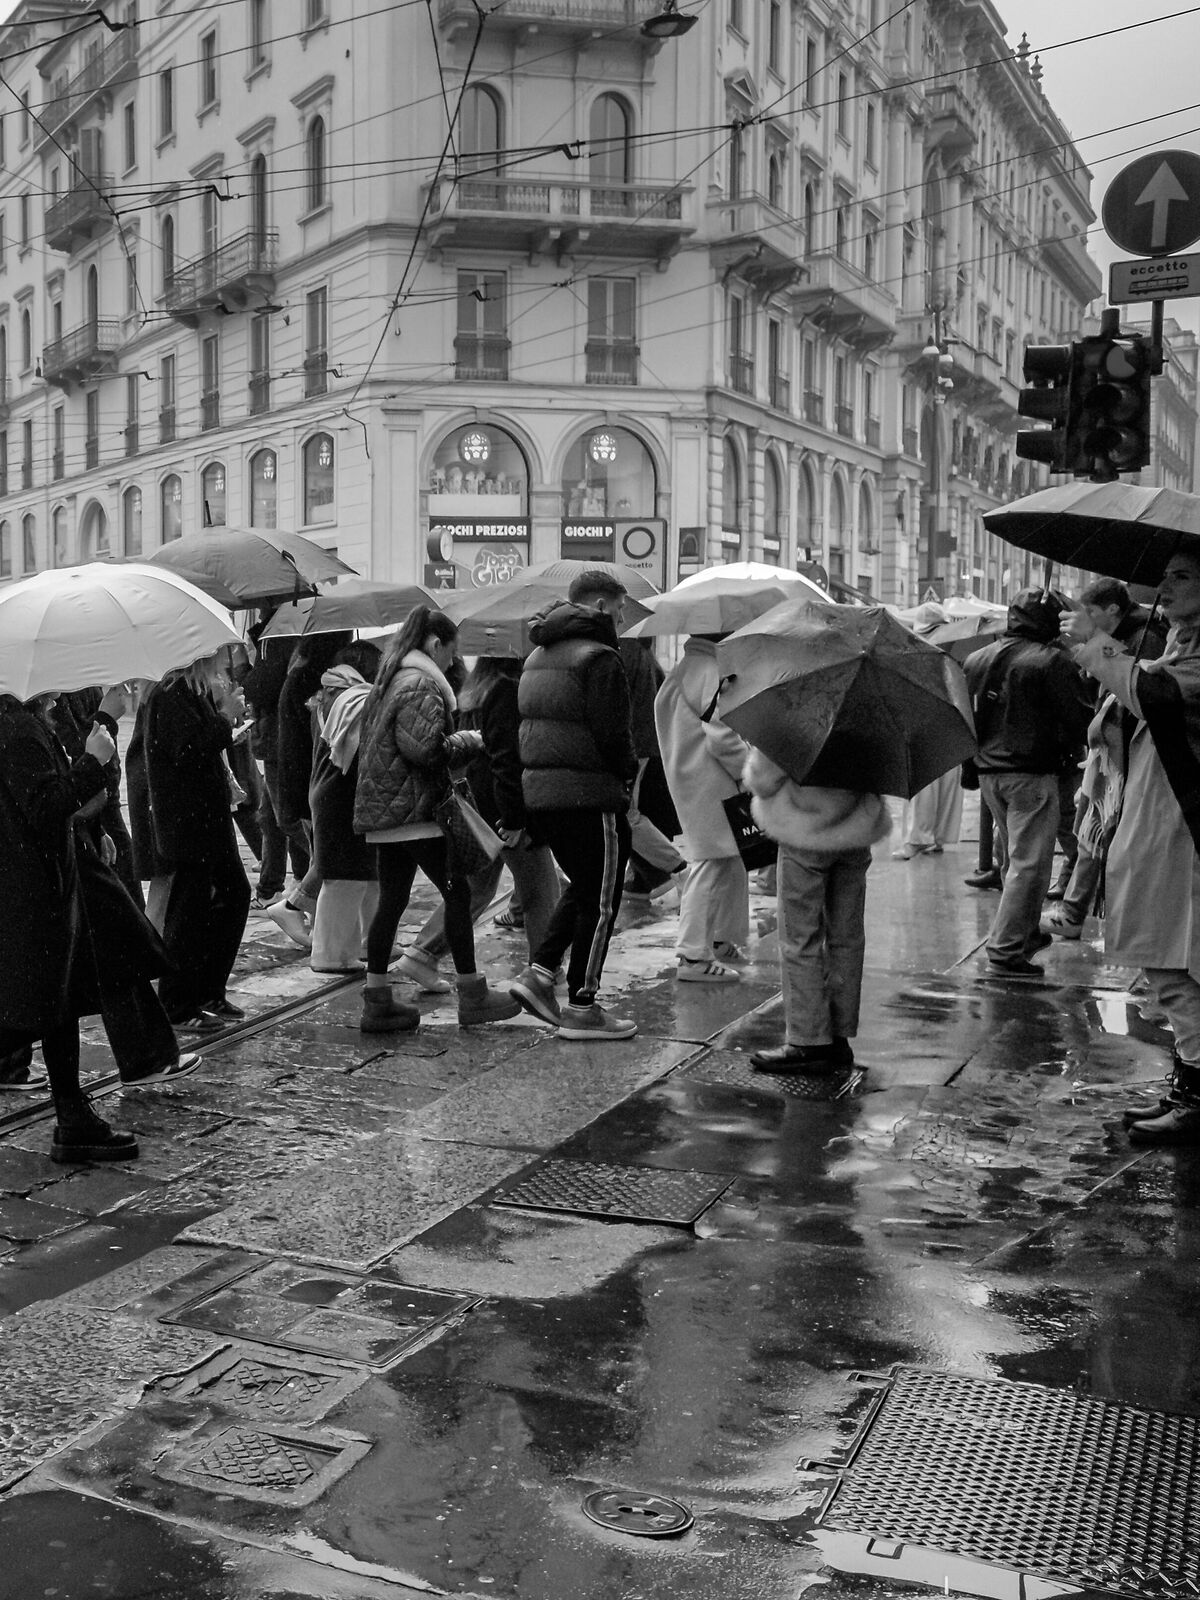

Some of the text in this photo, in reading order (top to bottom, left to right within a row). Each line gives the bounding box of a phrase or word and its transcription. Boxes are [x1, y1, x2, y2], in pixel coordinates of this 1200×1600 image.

[1130, 261, 1188, 275] eccetto
[475, 525, 527, 536] PREZIOSI
[564, 526, 603, 537] GIOCHI
